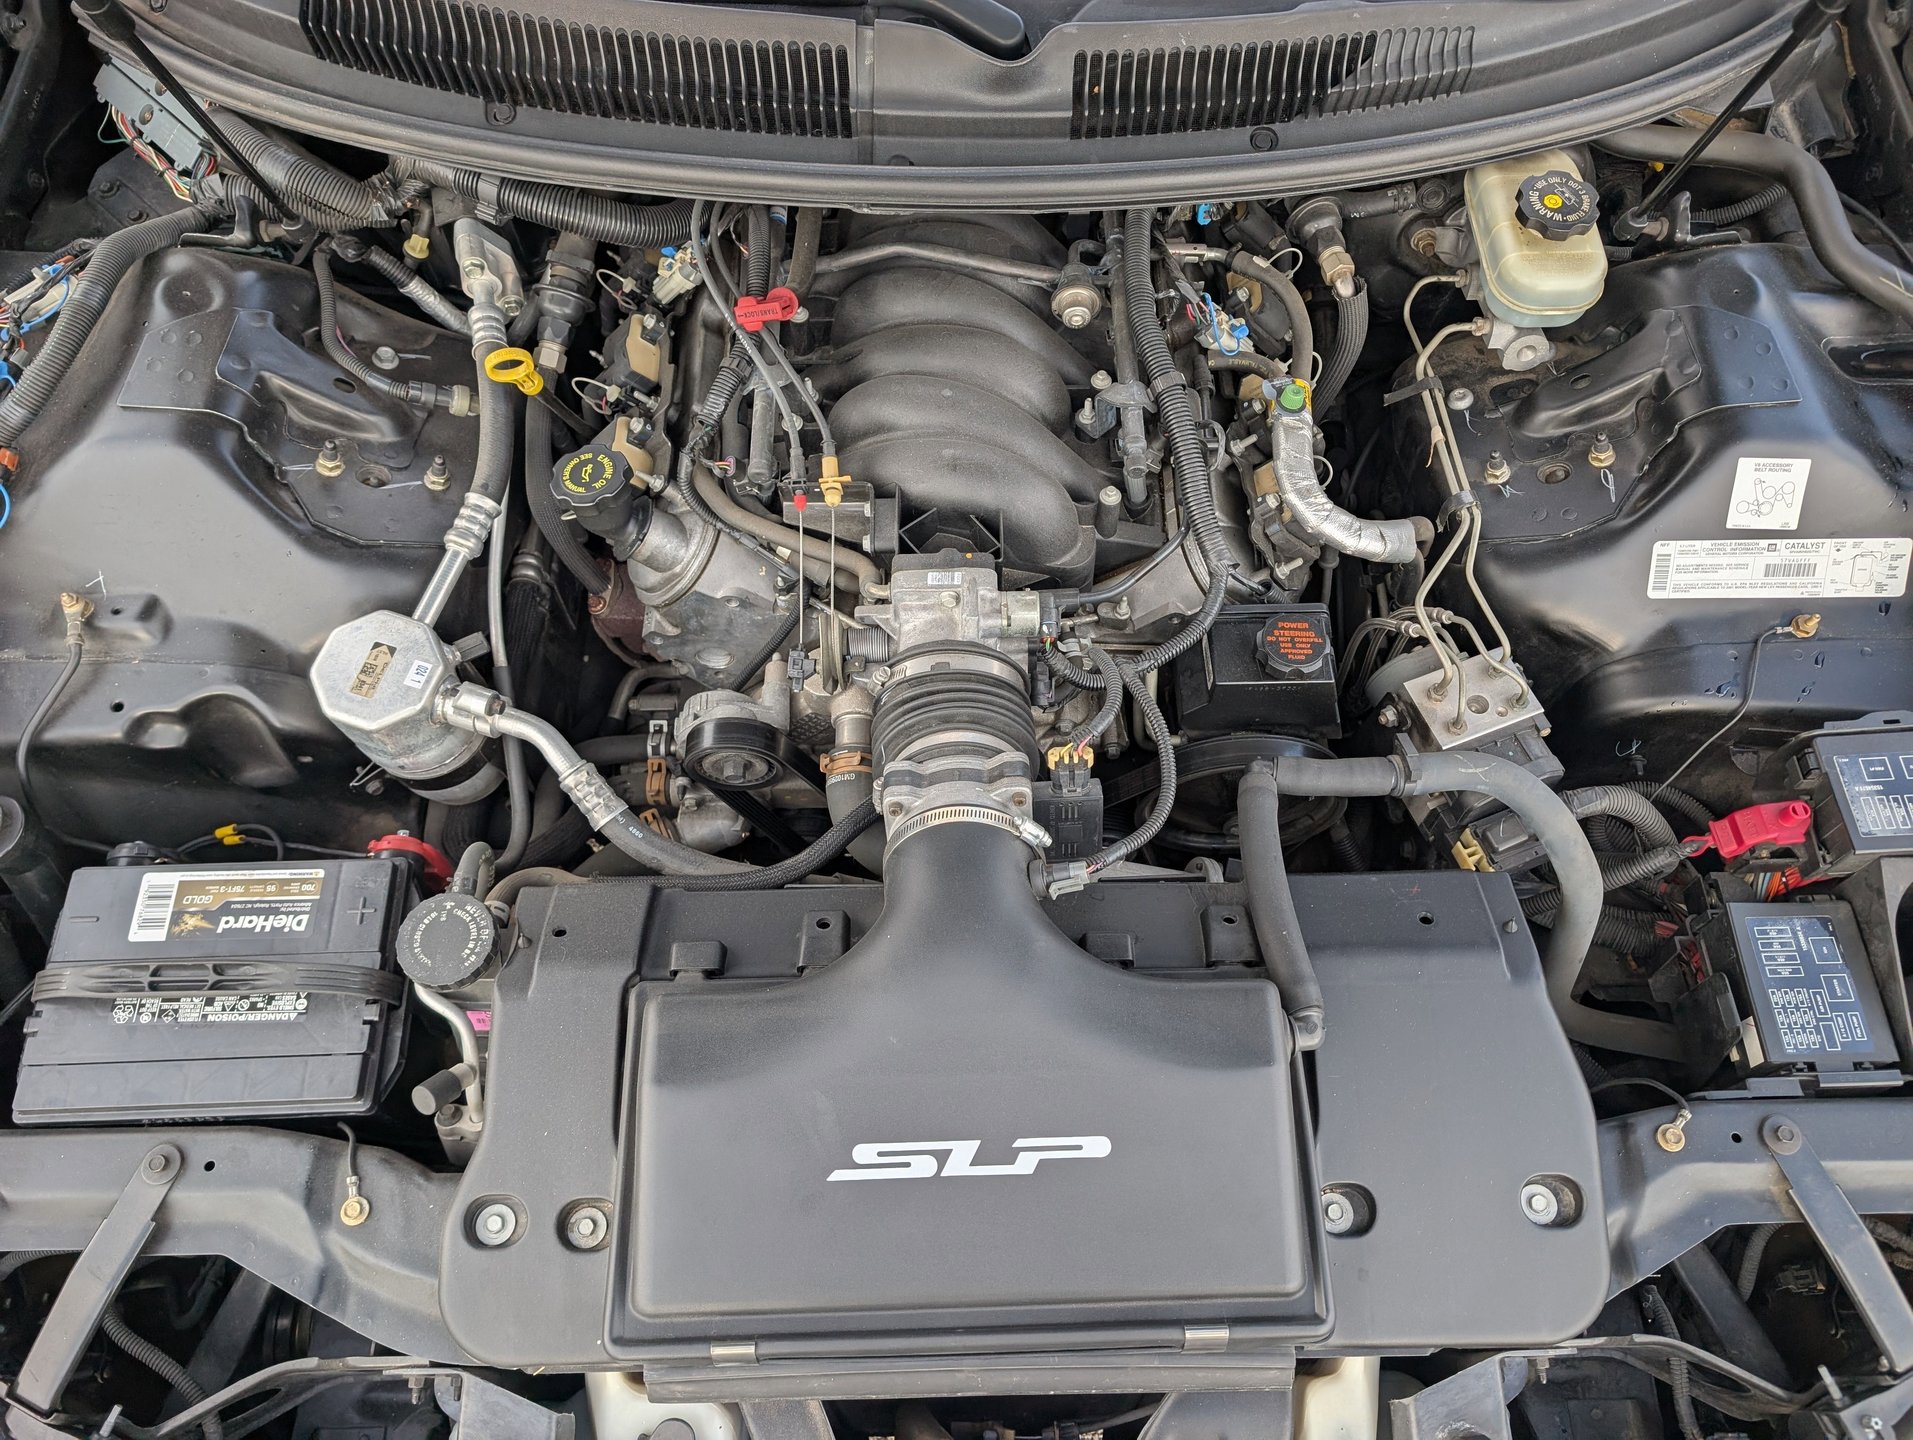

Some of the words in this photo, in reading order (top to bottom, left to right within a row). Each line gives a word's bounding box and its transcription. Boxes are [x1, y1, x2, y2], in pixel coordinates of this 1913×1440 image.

[1568, 180, 1580, 190] DOT
[1529, 190, 1563, 222] WARNING
[1581, 195, 1590, 213] BRAKE
[1566, 209, 1586, 221] FLUID
[579, 452, 593, 460] SEE
[597, 454, 614, 479] ENGINE
[592, 479, 607, 489] OIL
[1785, 542, 1826, 550] CATALYST
[219, 885, 246, 893] 75FT-3
[302, 883, 317, 892] 700
[182, 895, 214, 905] GOLD
[453, 908, 473, 923] CHECK
[215, 914, 311, 934] DieHard
[468, 921, 478, 940] LEVEL
[467, 940, 476, 949] IN
[1832, 978, 1842, 997] STARTER
[207, 1013, 290, 1022] DANGER/POISON
[826, 1135, 1112, 1182] SLP
